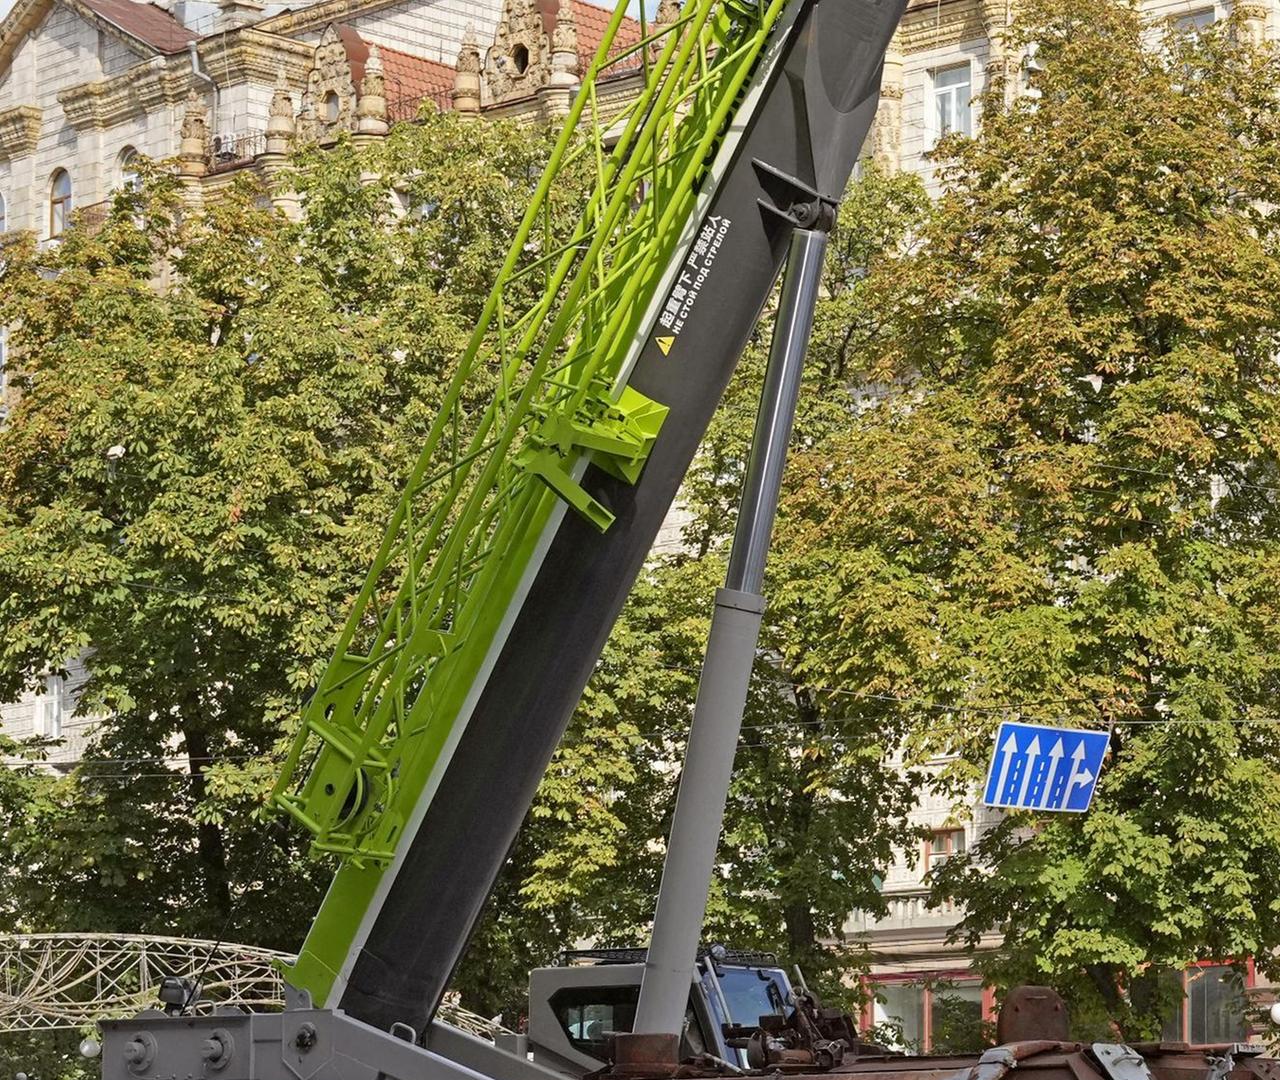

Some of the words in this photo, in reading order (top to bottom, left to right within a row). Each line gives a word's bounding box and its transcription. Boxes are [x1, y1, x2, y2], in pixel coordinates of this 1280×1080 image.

[672, 320, 685, 335] НЕ
[681, 291, 698, 318] СТОЙ
[694, 266, 710, 292] ПОД
[704, 219, 731, 268] СТРЕЛОЙ
